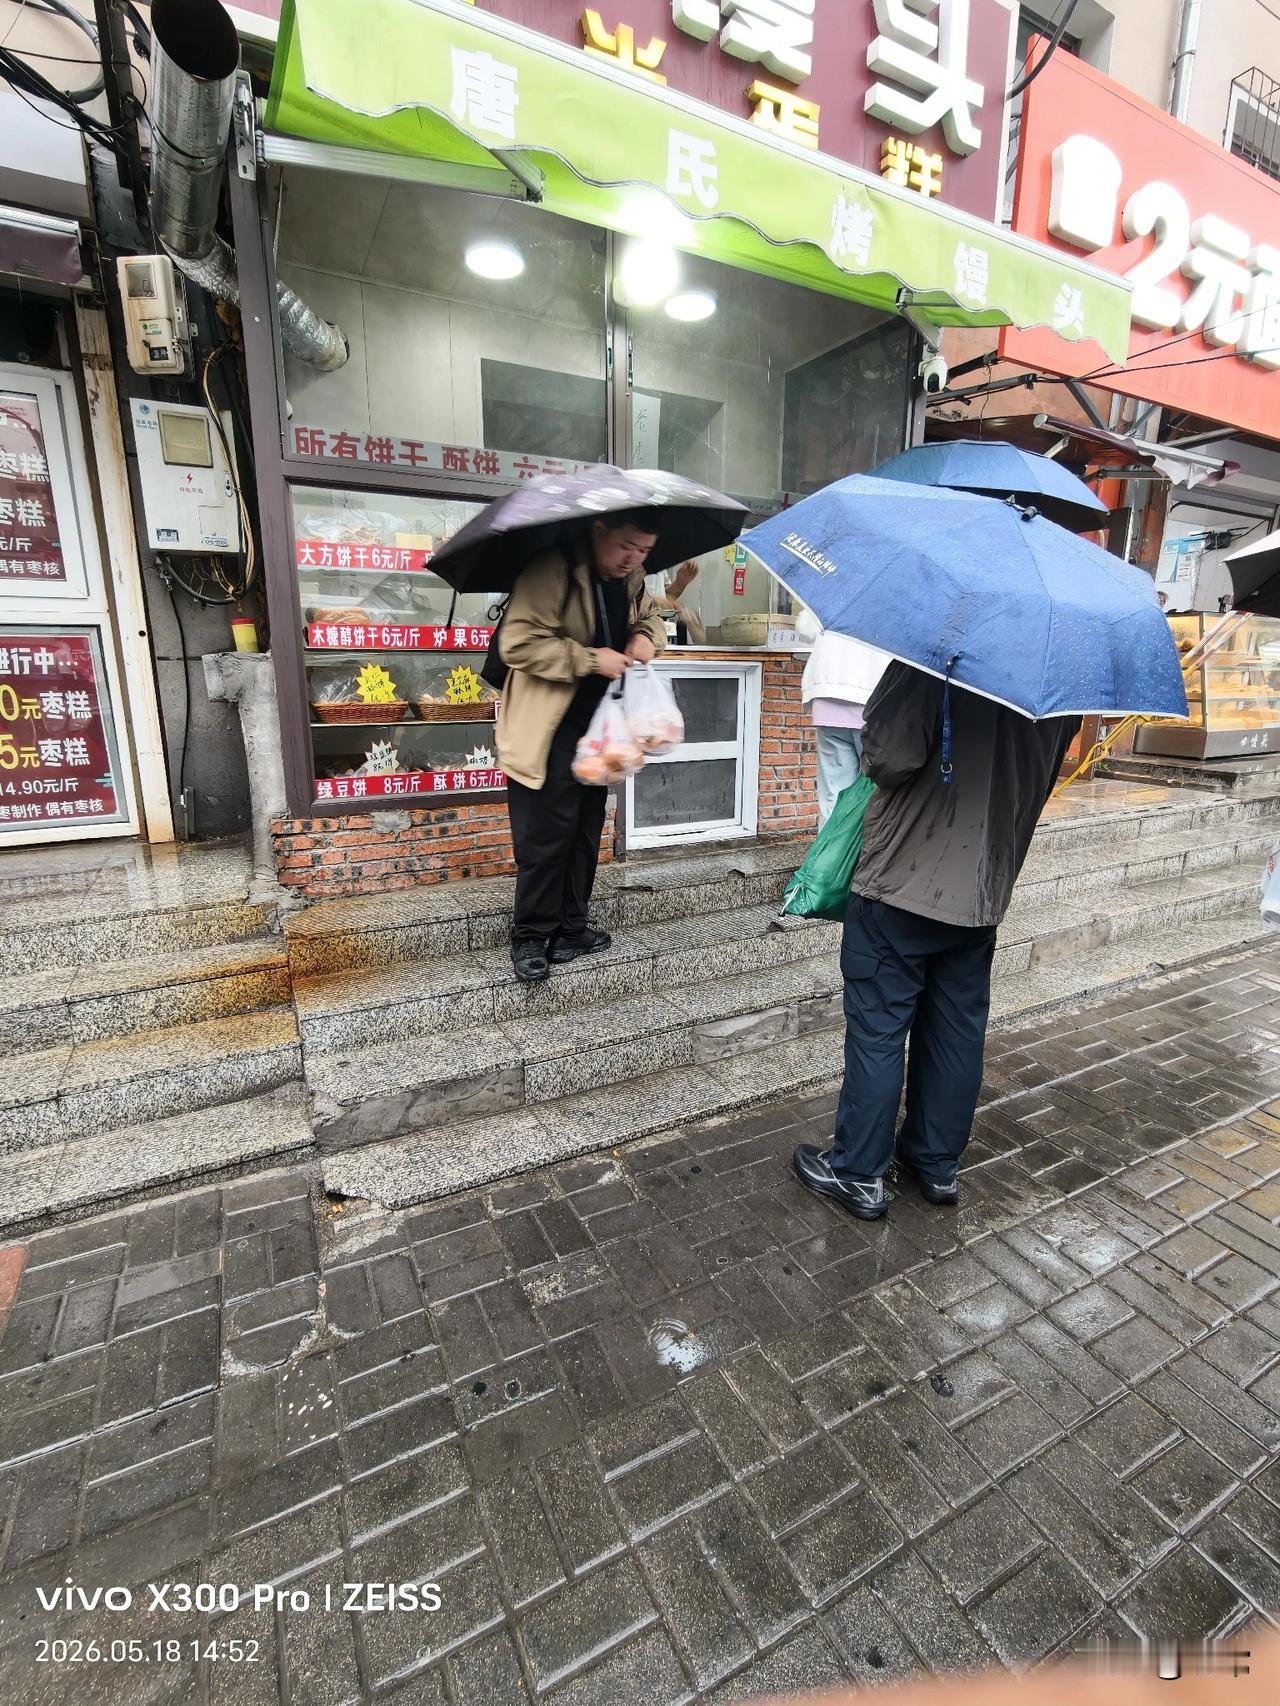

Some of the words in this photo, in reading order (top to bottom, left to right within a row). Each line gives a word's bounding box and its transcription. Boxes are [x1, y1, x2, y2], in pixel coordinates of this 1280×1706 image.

[450, 46, 1086, 335] 唐氏烤馒头
[295, 427, 428, 466] 所有饼干
